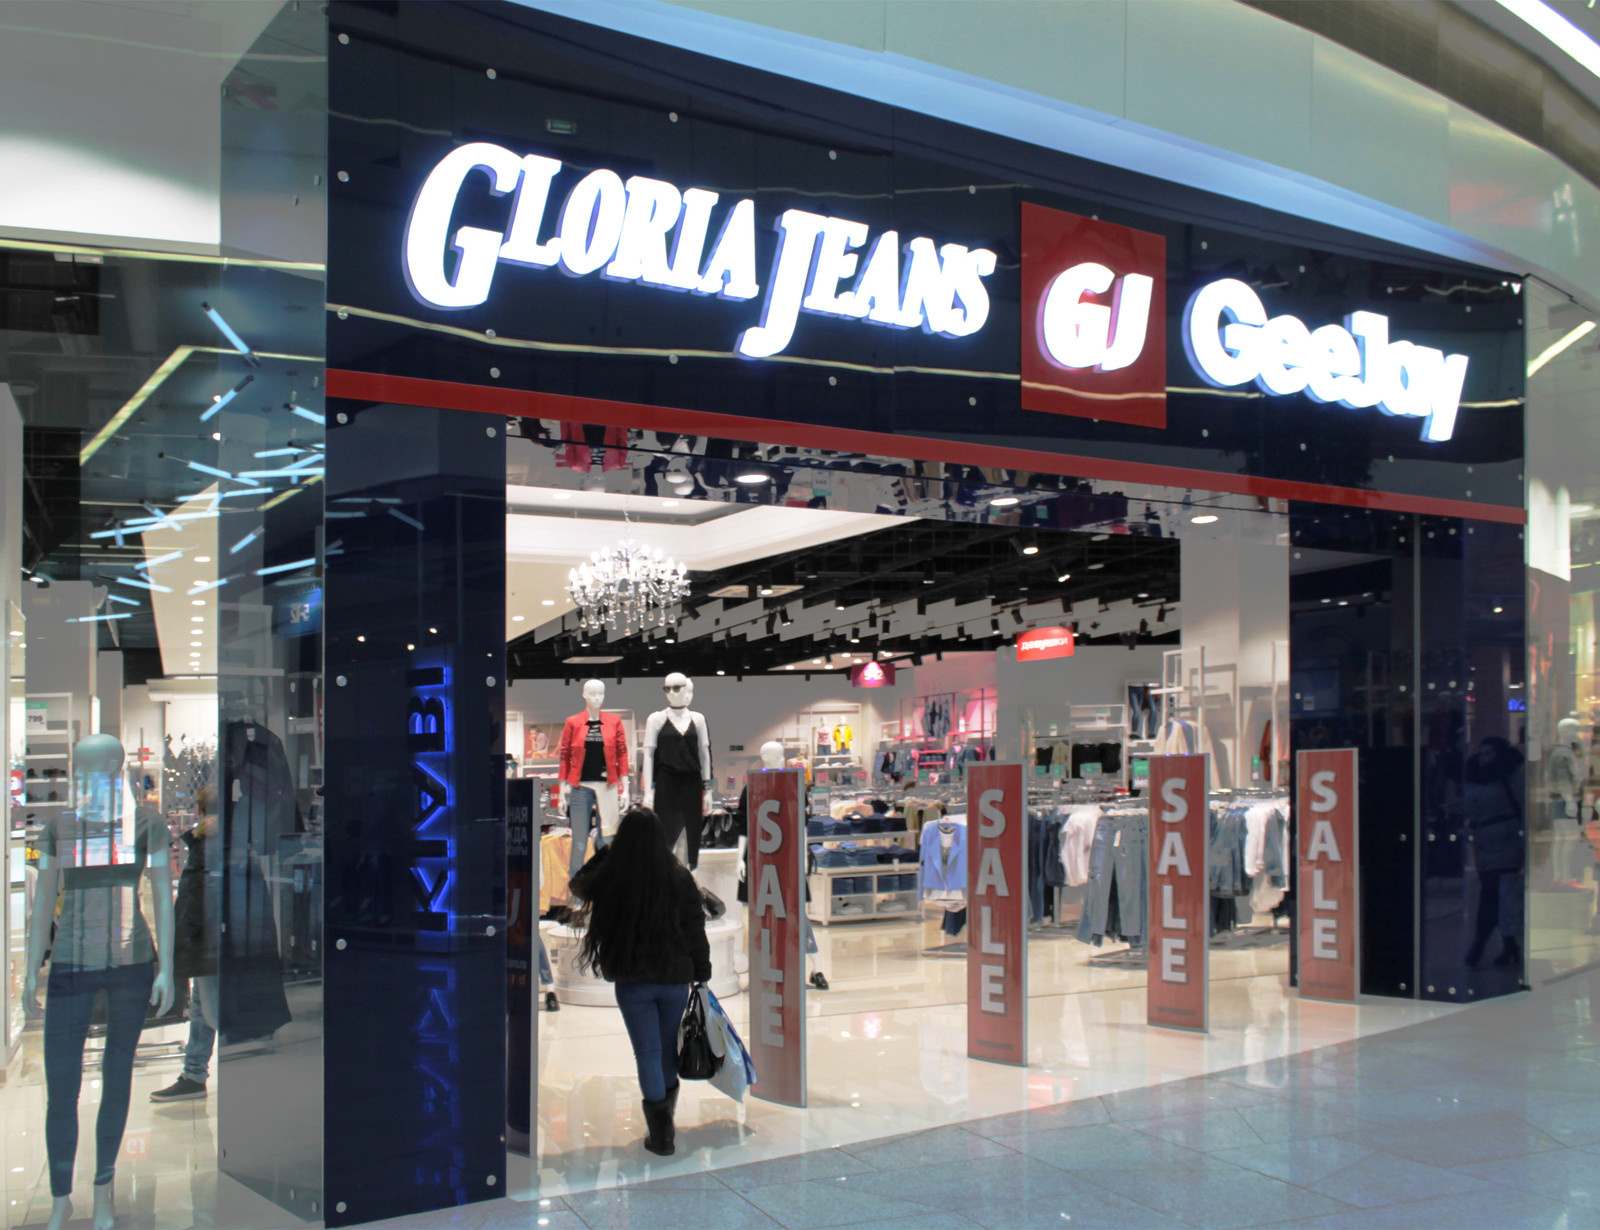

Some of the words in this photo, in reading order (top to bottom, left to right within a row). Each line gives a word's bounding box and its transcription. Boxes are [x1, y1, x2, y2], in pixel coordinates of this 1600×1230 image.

[402, 142, 760, 310] GLORIA
[734, 208, 998, 360] JEANS
[1036, 262, 1154, 373] GJ
[756, 799, 787, 1048] SALE
[975, 789, 1010, 1015] SALE
[1157, 777, 1192, 984] SALE
[1307, 771, 1342, 960] SALE
